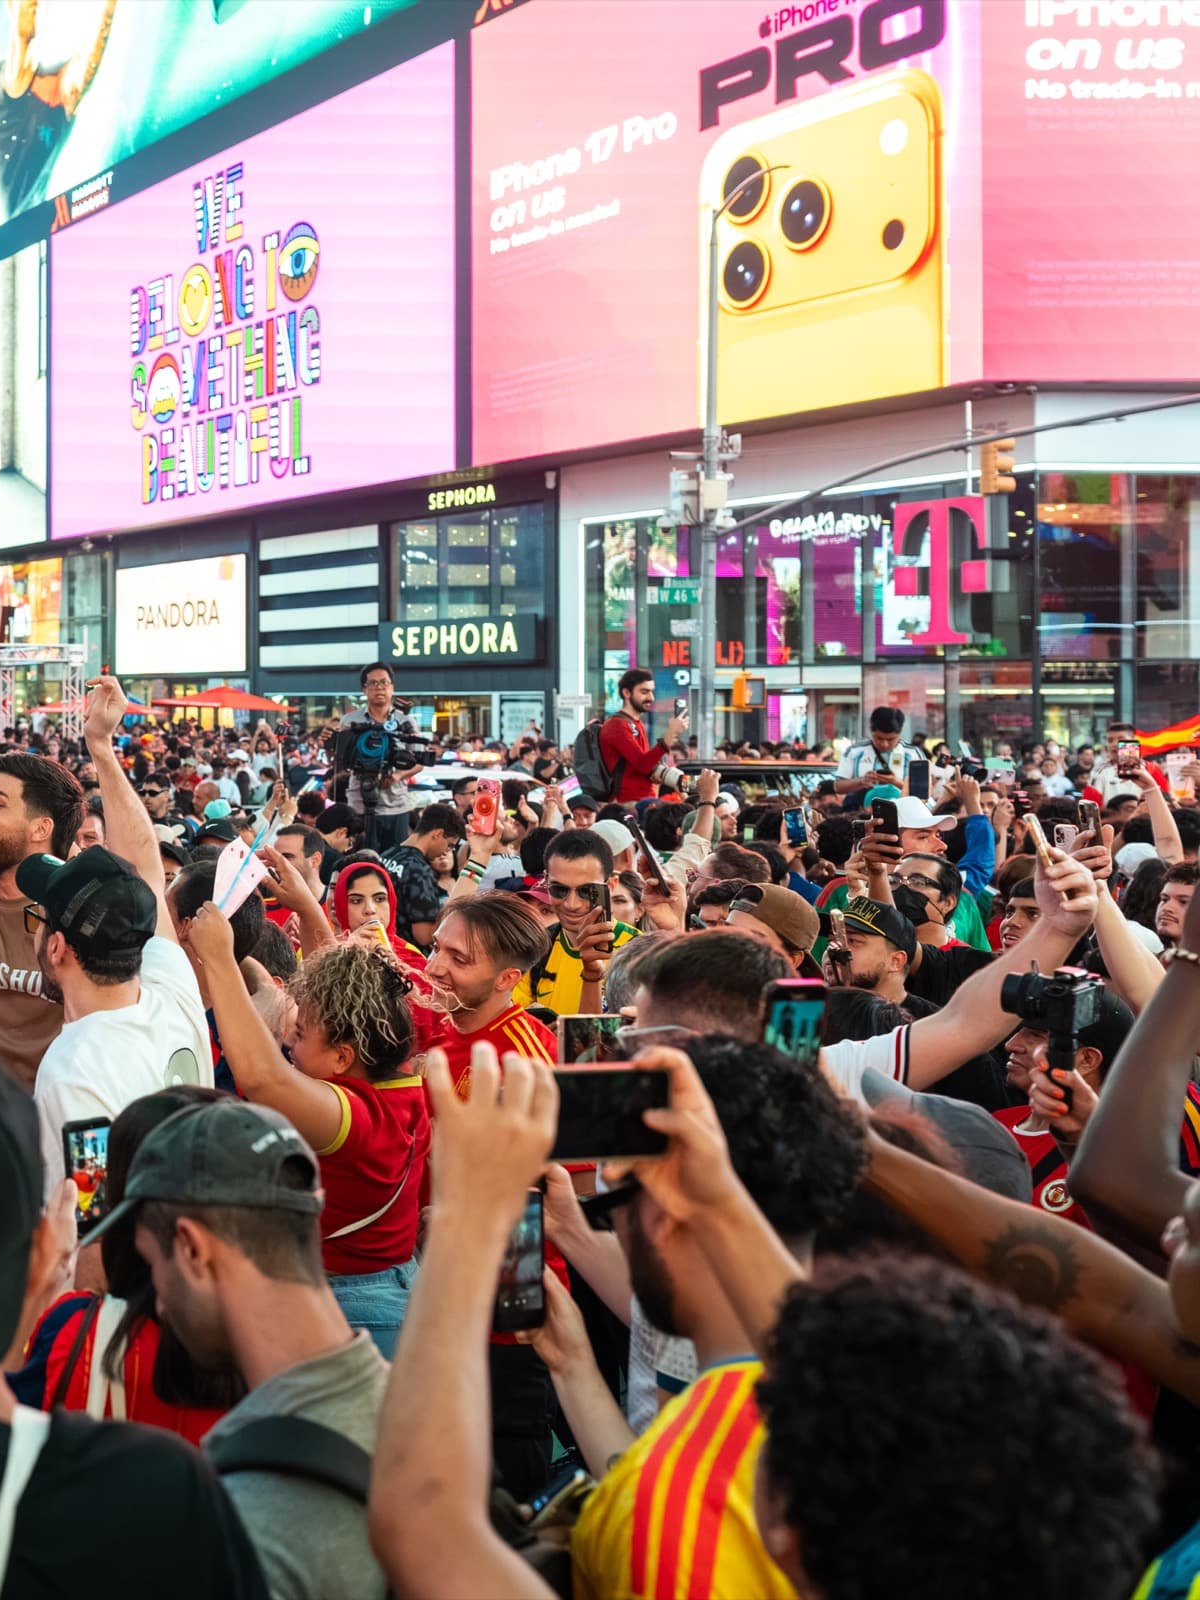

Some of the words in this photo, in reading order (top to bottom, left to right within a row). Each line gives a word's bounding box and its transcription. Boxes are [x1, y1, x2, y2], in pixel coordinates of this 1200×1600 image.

[698, 0, 947, 132] PRO
[1025, 37, 1102, 71] on
[1114, 37, 1186, 71] us
[1025, 77, 1067, 100] No
[585, 124, 620, 164] 17
[622, 111, 678, 153] Pro
[192, 161, 245, 254] WE
[490, 199, 526, 232] on
[530, 187, 568, 219] us
[130, 243, 254, 357] BELONG
[262, 221, 321, 312] TO
[130, 304, 321, 431] SOMETHING
[142, 395, 311, 505] BEAUTIFUL
[427, 483, 497, 511] SEPHORA
[136, 598, 221, 630] PANDORA
[659, 589, 670, 603] W
[673, 589, 688, 603] 46
[391, 620, 519, 657] SEPHORA
